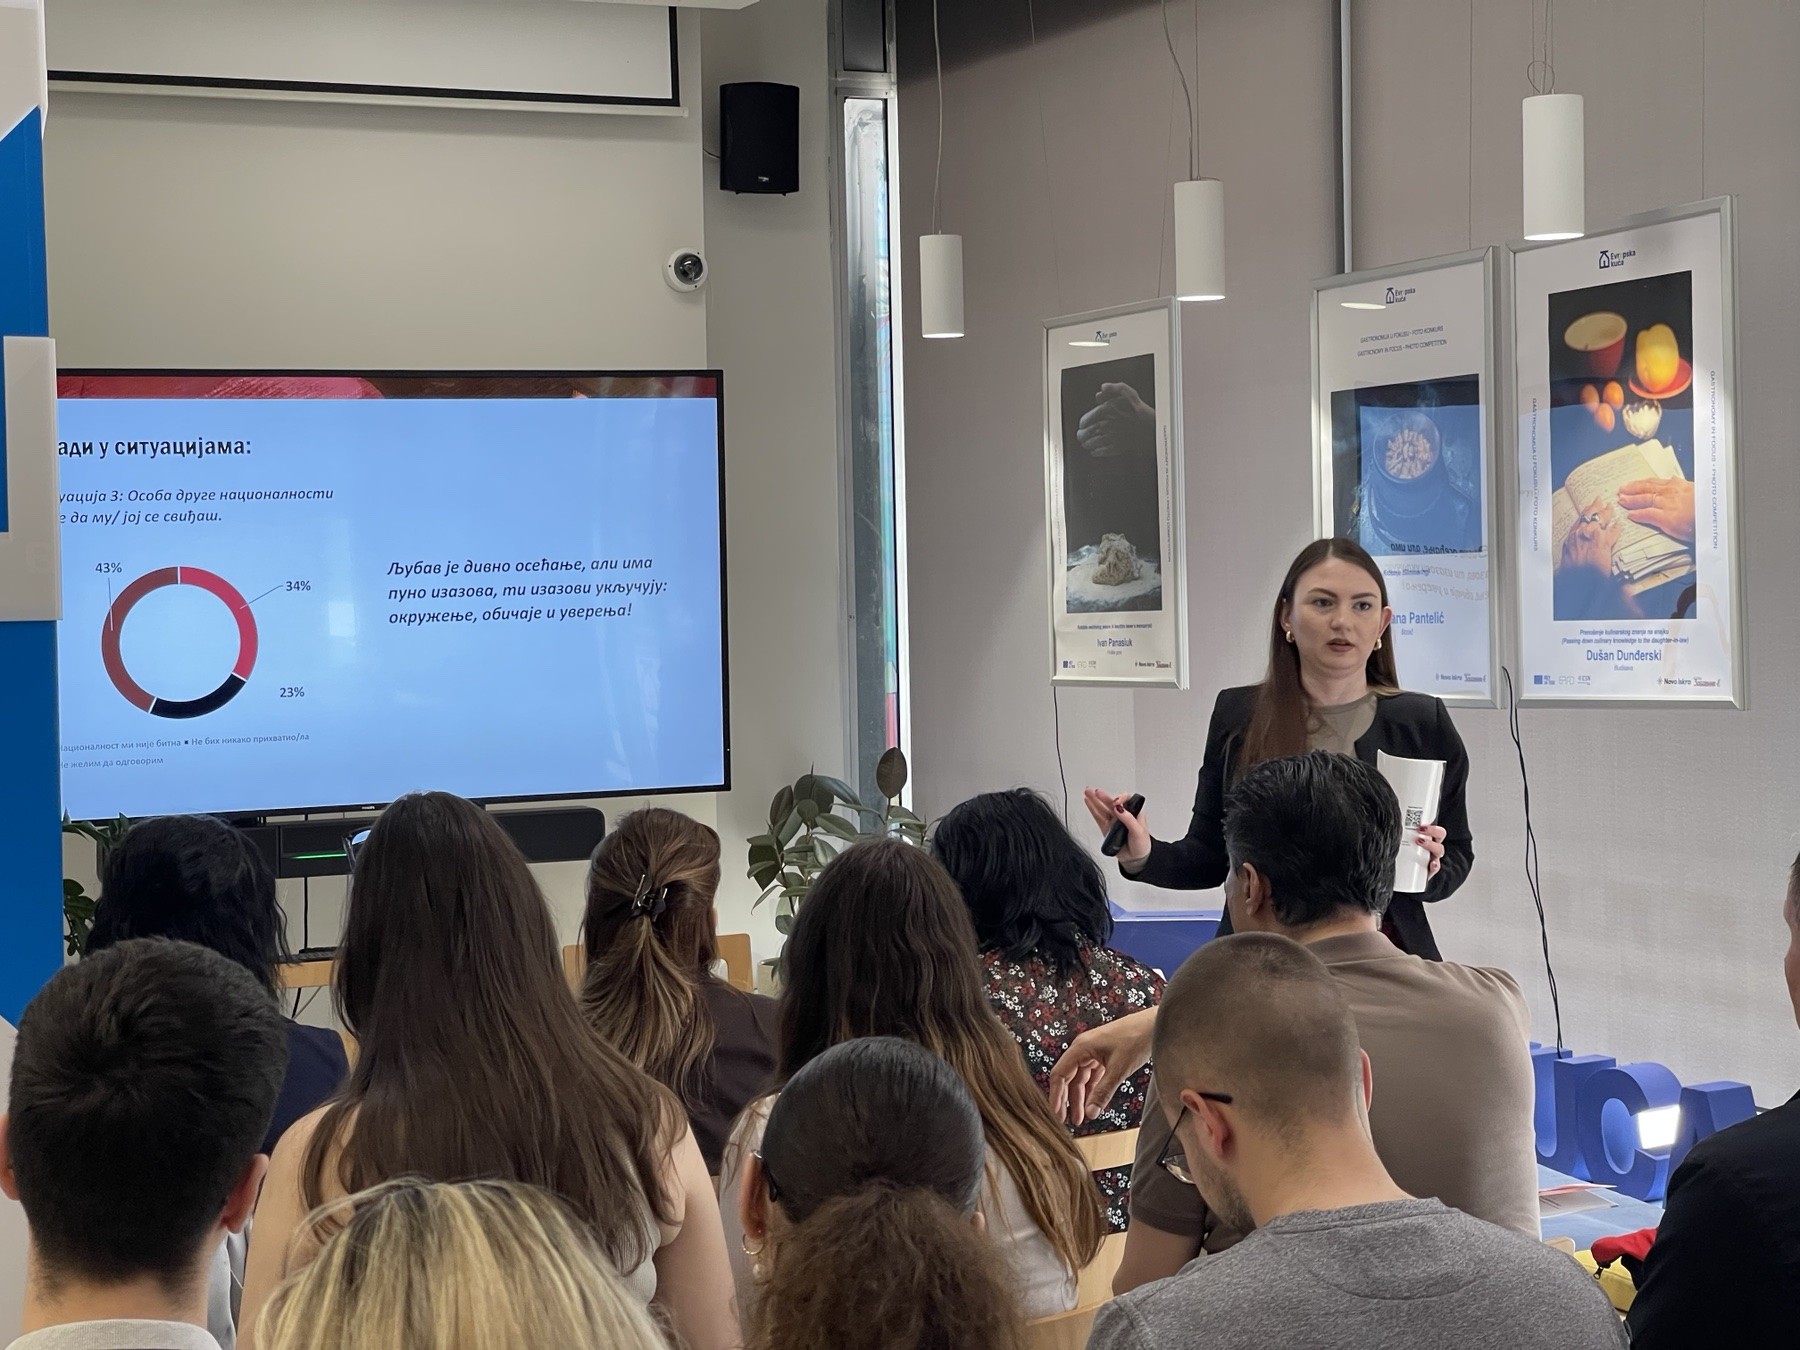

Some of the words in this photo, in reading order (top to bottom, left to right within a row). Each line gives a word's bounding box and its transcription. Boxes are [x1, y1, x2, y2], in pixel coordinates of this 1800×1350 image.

[1610, 250, 1636, 260] Evrpska
[58, 440, 94, 458] ади
[99, 441, 109, 459] у
[114, 437, 252, 459] ситуацијама:
[59, 489, 106, 503] уација
[110, 490, 124, 502] 3:
[128, 488, 172, 502] Особа
[176, 488, 216, 505] друге
[220, 488, 334, 502] националности
[70, 510, 88, 524] да
[92, 510, 120, 527] му/
[122, 510, 141, 526] јој
[144, 512, 160, 524] се
[163, 510, 222, 524] свиђаш.
[95, 562, 122, 574] 43%
[387, 560, 442, 578] Љубав
[444, 560, 460, 578] је
[464, 558, 511, 574] дивно
[515, 558, 586, 574] осећање,
[590, 559, 618, 571] али
[622, 558, 653, 570] има
[286, 580, 312, 592] 34%
[388, 586, 427, 602] пуно
[431, 584, 498, 600] изазова,
[502, 584, 526, 597] ти
[530, 582, 592, 596] изазови
[596, 580, 668, 597] укључују:
[388, 608, 478, 626] окружење,
[482, 605, 542, 623] обичаје
[546, 606, 556, 619] и
[560, 602, 632, 621] уверења!
[1391, 614, 1406, 624] ana
[1410, 611, 1445, 624] Pantelić
[1096, 638, 1108, 647] Ivan
[1612, 637, 1638, 645] knowledge
[1586, 648, 1614, 661] Dušan
[1616, 649, 1662, 661] Dunđerski
[279, 686, 305, 698] 23%
[120, 742, 134, 750] ми
[136, 740, 154, 750] није
[156, 740, 182, 749] битна
[191, 738, 203, 746] Не
[204, 736, 220, 746] бих
[222, 736, 251, 745] никако
[252, 733, 310, 744] прихватио/ла
[70, 760, 101, 768] желим
[102, 760, 114, 768] да
[116, 756, 164, 768] одговорим
